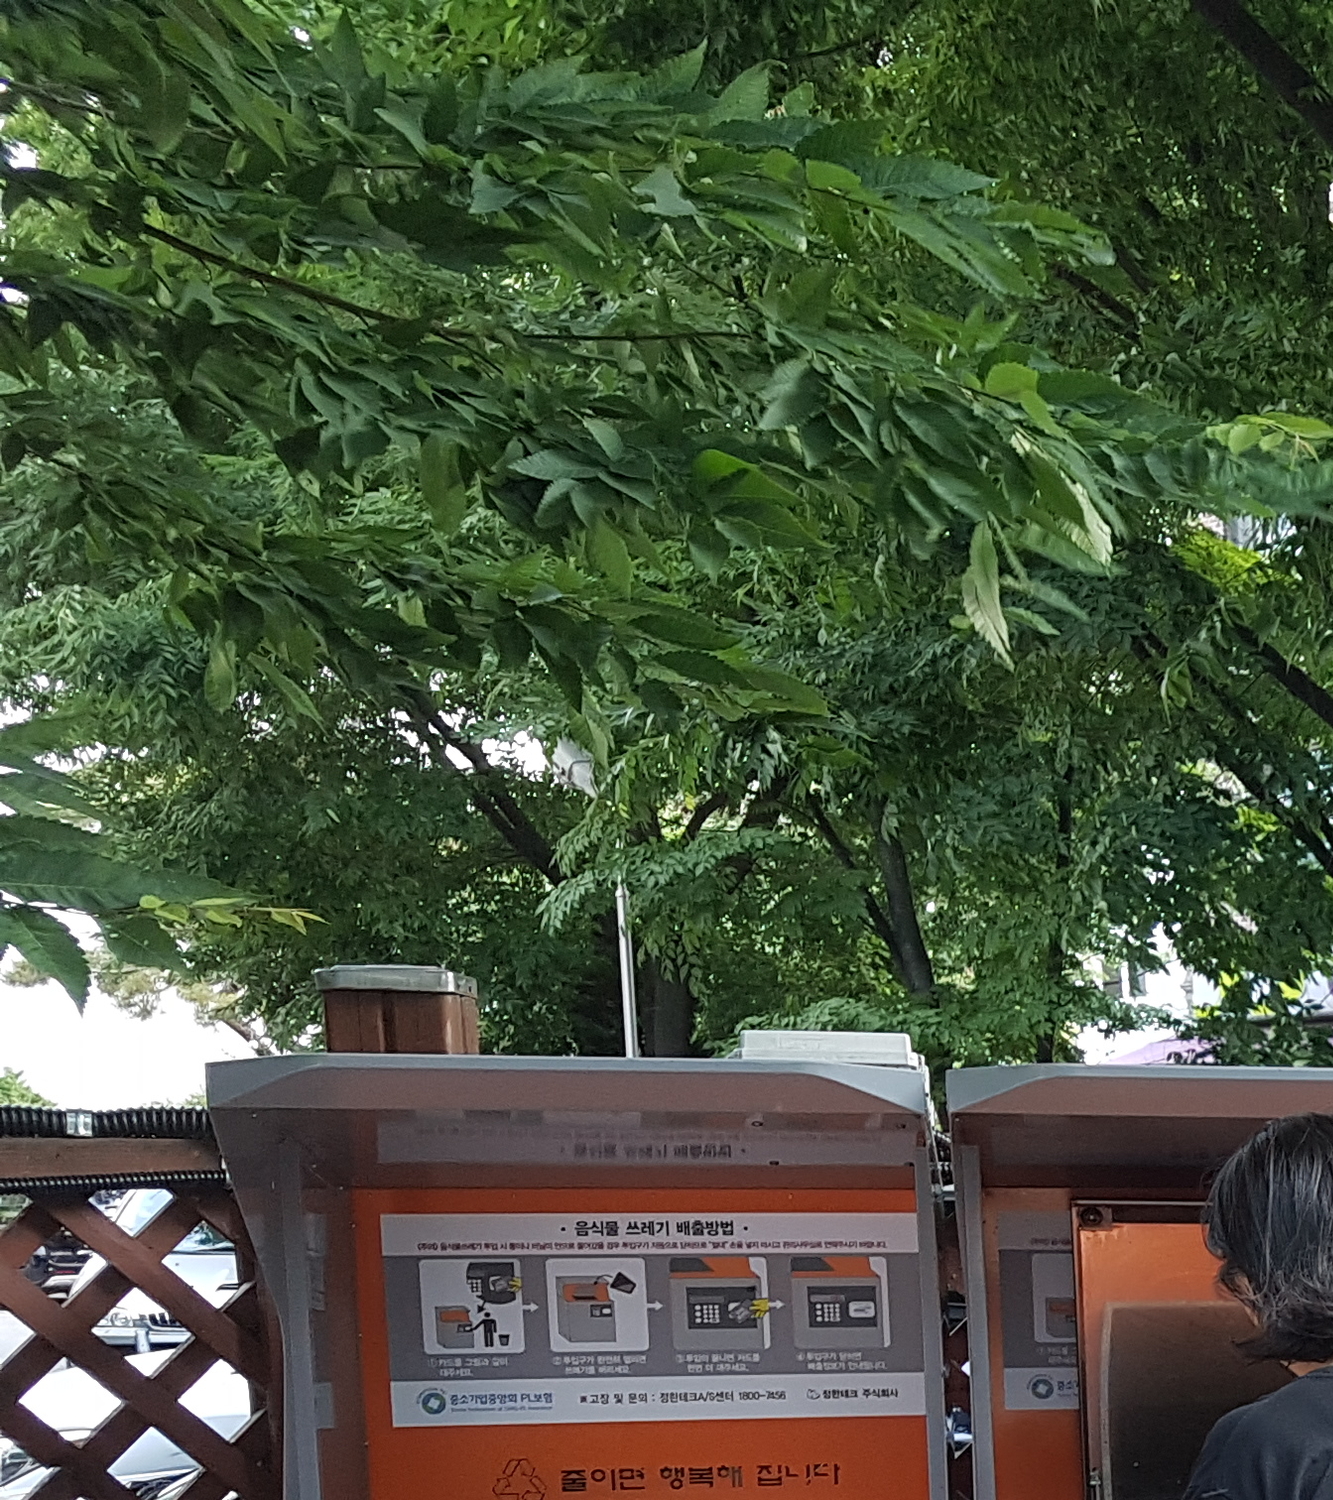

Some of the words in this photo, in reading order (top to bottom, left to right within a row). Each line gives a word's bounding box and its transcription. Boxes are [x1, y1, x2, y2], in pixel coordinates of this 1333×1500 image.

[574, 1220, 619, 1237] 음식물
[625, 1220, 670, 1237] 쓰레기
[676, 1220, 734, 1237] 배출방법
[589, 1393, 609, 1405] 고장
[613, 1393, 623, 1405] 및
[628, 1393, 648, 1404] 문의
[862, 1388, 899, 1399] 주식회사
[450, 1394, 517, 1406] 중소기업중앙회
[561, 1467, 646, 1492] 줄이면
[659, 1464, 744, 1491] 행복해
[756, 1463, 841, 1487] 집니다
